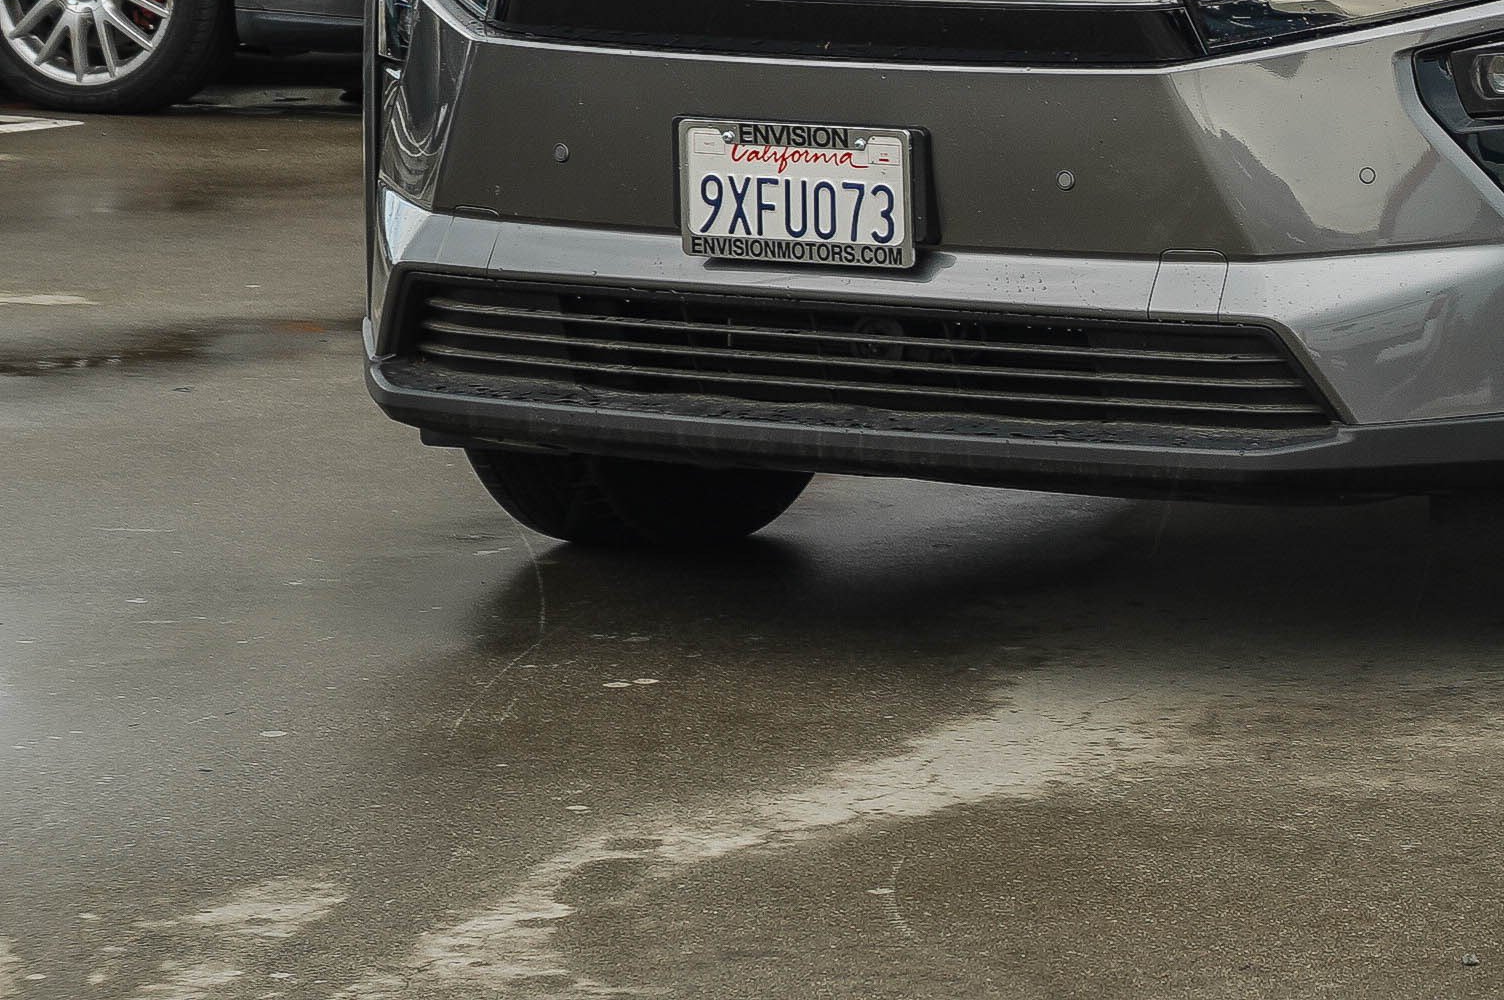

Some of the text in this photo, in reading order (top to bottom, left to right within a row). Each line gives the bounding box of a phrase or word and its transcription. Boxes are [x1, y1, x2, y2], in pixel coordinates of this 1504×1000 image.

[739, 123, 849, 148] ENVISION
[731, 143, 869, 173] California
[699, 174, 895, 244] 9XFU073
[690, 236, 902, 266] ENVISIONMOTORS.COM
